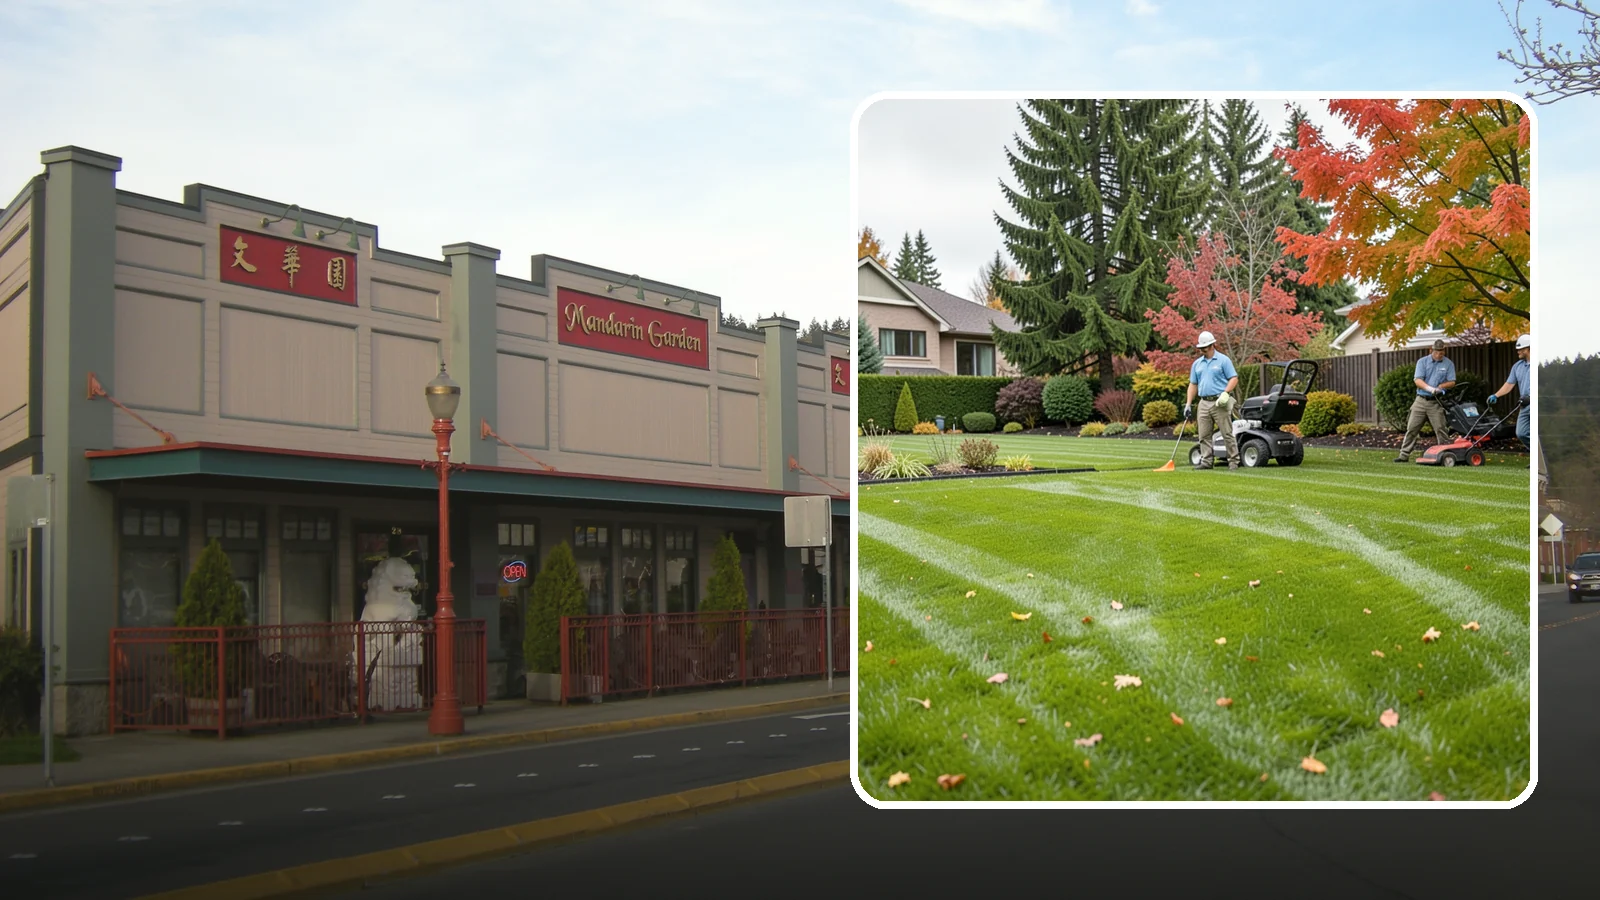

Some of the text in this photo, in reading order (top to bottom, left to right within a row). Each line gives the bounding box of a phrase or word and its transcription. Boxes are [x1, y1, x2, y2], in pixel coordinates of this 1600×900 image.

[231, 236, 346, 290] 文華園
[565, 302, 701, 352] Mandarin Garden
[503, 565, 527, 578] OPEN
